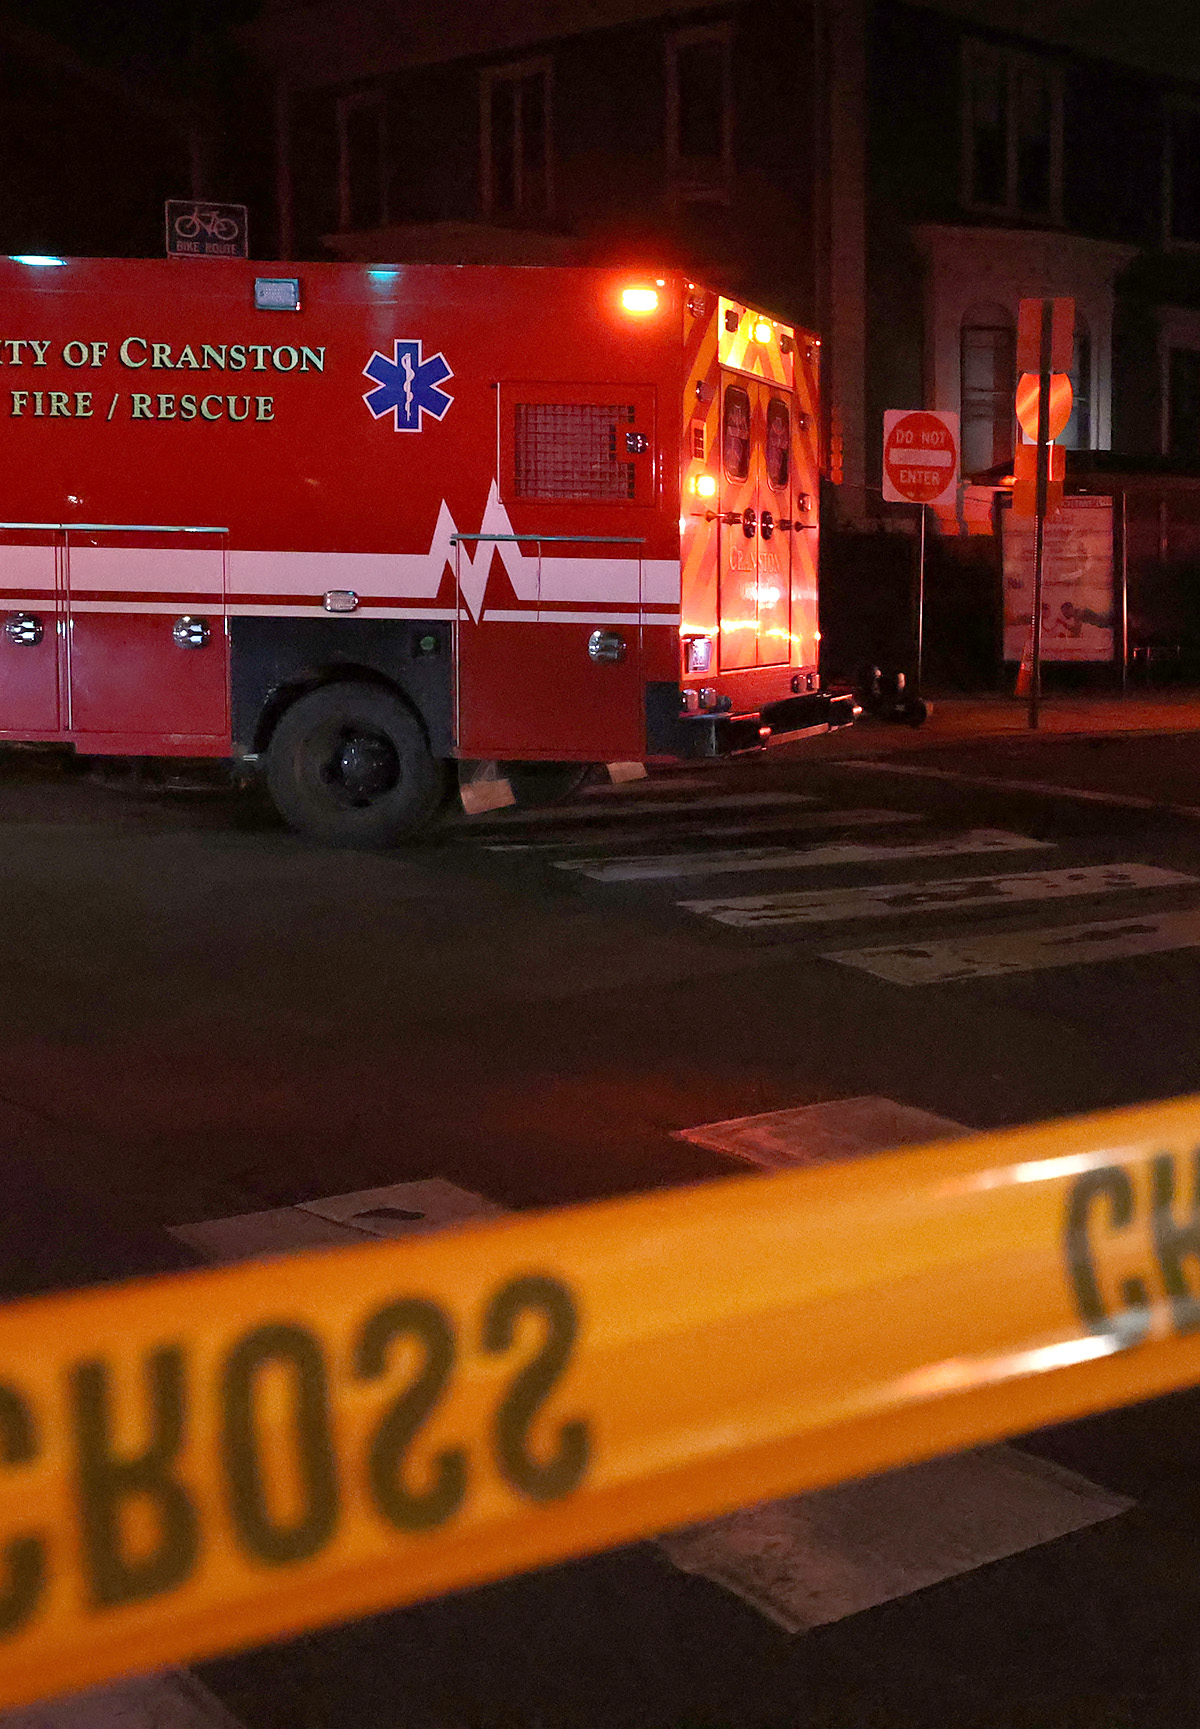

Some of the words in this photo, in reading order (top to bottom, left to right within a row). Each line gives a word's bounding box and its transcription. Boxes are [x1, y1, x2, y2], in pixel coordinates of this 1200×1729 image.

[176, 241, 200, 253] BIKE
[205, 243, 237, 256] ROUTE
[0, 340, 51, 366] TY
[63, 341, 108, 368] OF
[119, 337, 326, 373] CRANSTON
[10, 391, 93, 417] FIRE
[107, 393, 119, 420] /
[131, 393, 275, 421] RESCUE
[896, 430, 914, 444] DO
[922, 431, 946, 446] NOT
[900, 469, 940, 486] ENTER
